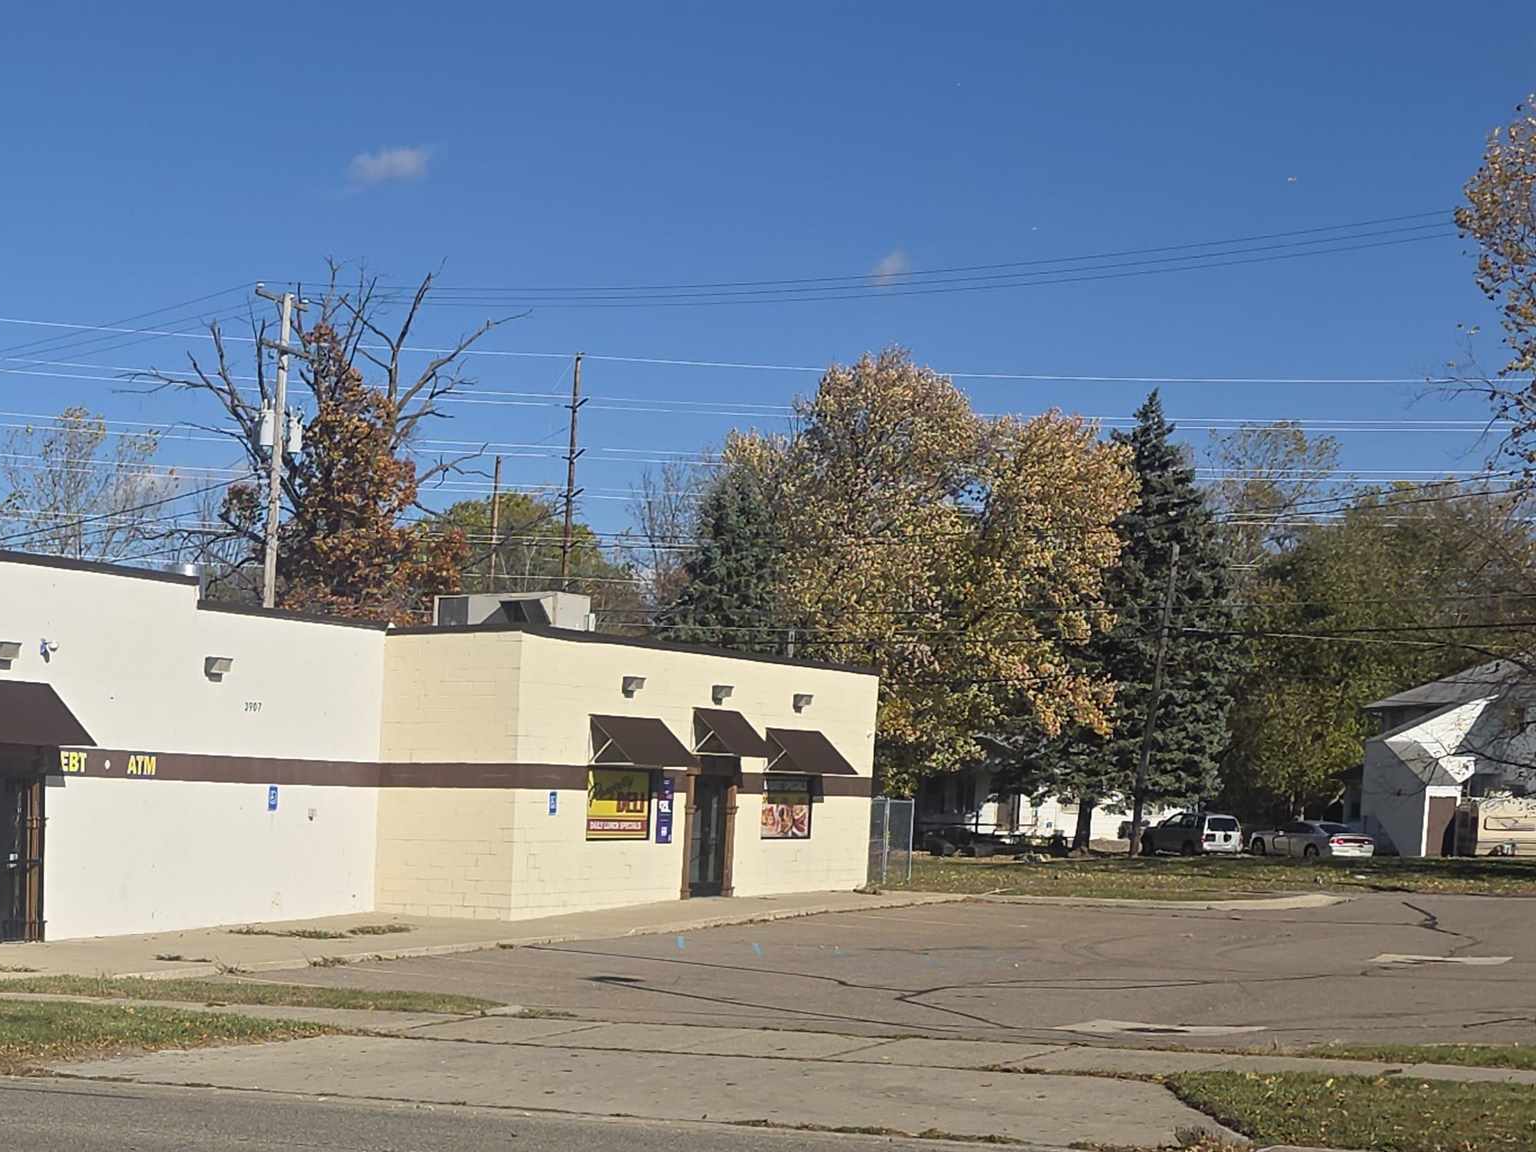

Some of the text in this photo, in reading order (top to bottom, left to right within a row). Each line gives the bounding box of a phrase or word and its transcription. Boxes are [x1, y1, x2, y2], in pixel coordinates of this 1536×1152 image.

[244, 702, 262, 712] 3907
[60, 750, 87, 772] EBT
[127, 755, 156, 776] ATM
